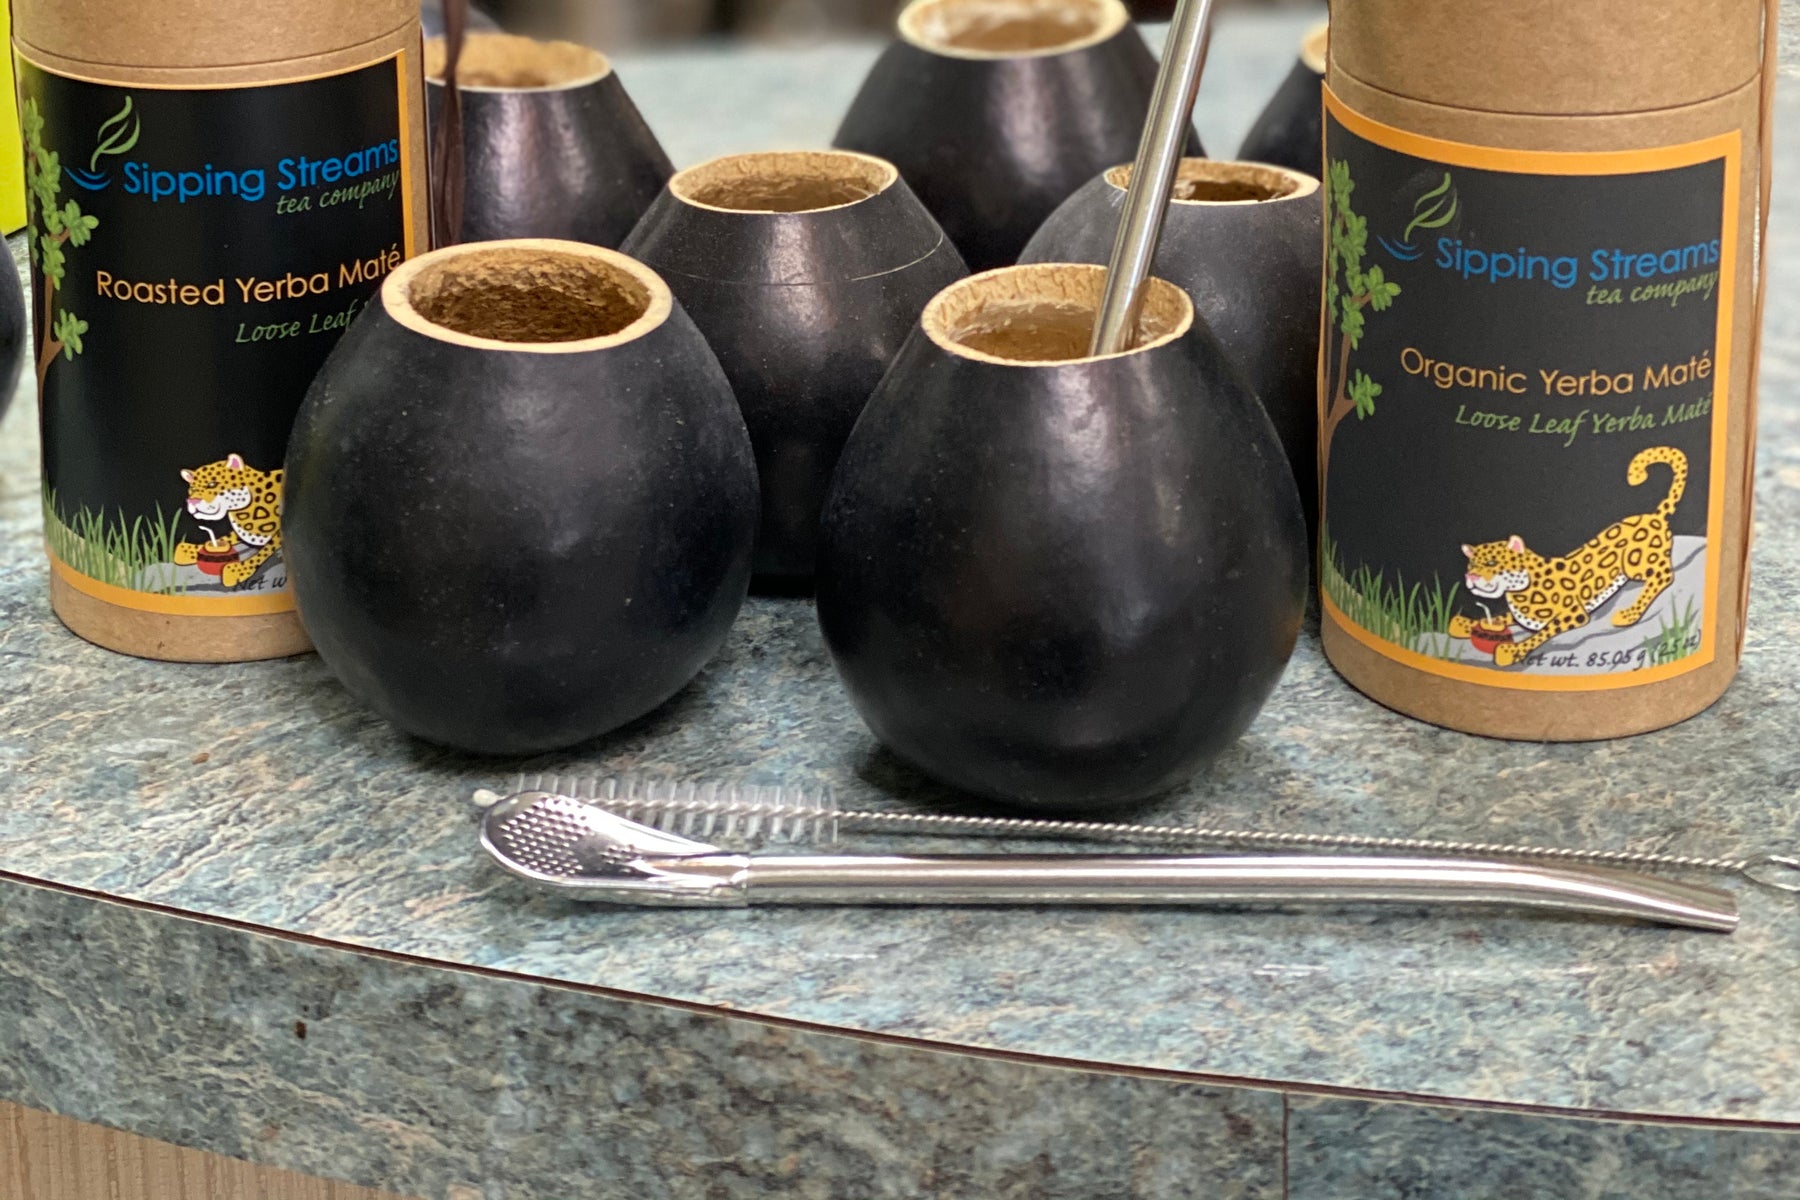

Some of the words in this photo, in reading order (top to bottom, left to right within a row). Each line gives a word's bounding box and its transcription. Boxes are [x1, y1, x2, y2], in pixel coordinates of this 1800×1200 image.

[123, 161, 266, 202] Sipping
[277, 138, 399, 191] Streams
[276, 195, 312, 215] tea
[318, 169, 400, 208] company
[96, 270, 225, 306] Roasted
[235, 273, 329, 302] Yerba
[338, 243, 401, 288] Maté
[1435, 237, 1578, 289] Sipping
[1589, 238, 1720, 282] Streams
[1586, 284, 1623, 305] tea
[1630, 269, 1718, 307] company
[235, 320, 300, 343] Loose
[308, 299, 359, 334] Leaf
[1400, 347, 1528, 394] Organic
[1539, 369, 1634, 396] Yerba
[1643, 350, 1712, 391] Maté
[1455, 404, 1521, 431] Loose
[1528, 410, 1588, 447] Leaf
[1592, 406, 1656, 434] Yerba
[1661, 392, 1713, 426] Maté
[1551, 653, 1580, 667] wt.
[1586, 650, 1634, 668] 85.05
